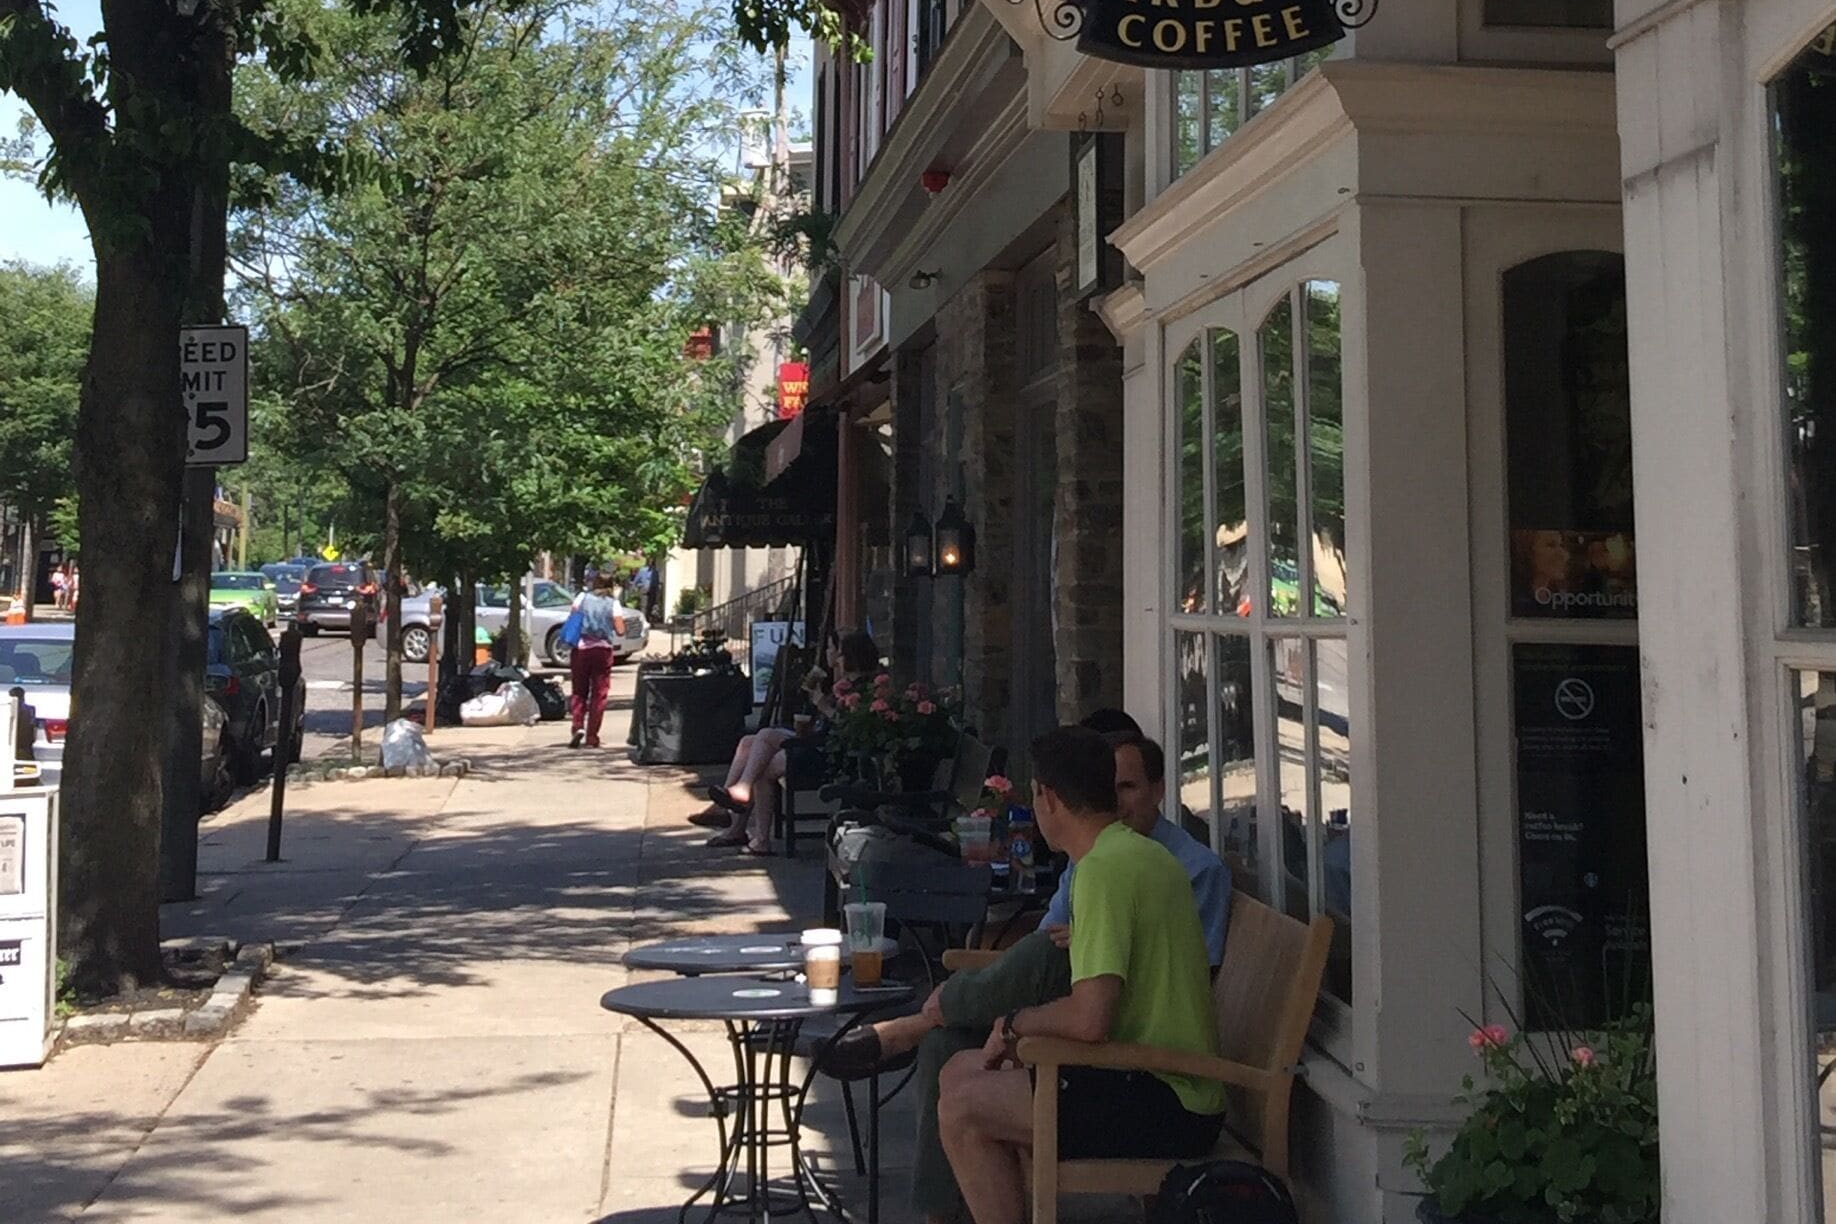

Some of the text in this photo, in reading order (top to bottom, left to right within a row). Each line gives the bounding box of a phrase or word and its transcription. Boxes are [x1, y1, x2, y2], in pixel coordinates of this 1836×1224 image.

[1117, 5, 1310, 53] COFFEE
[184, 342, 236, 363] EED
[182, 371, 227, 391] MIT
[195, 401, 231, 450] 5
[1535, 586, 1636, 611] Opportunit
